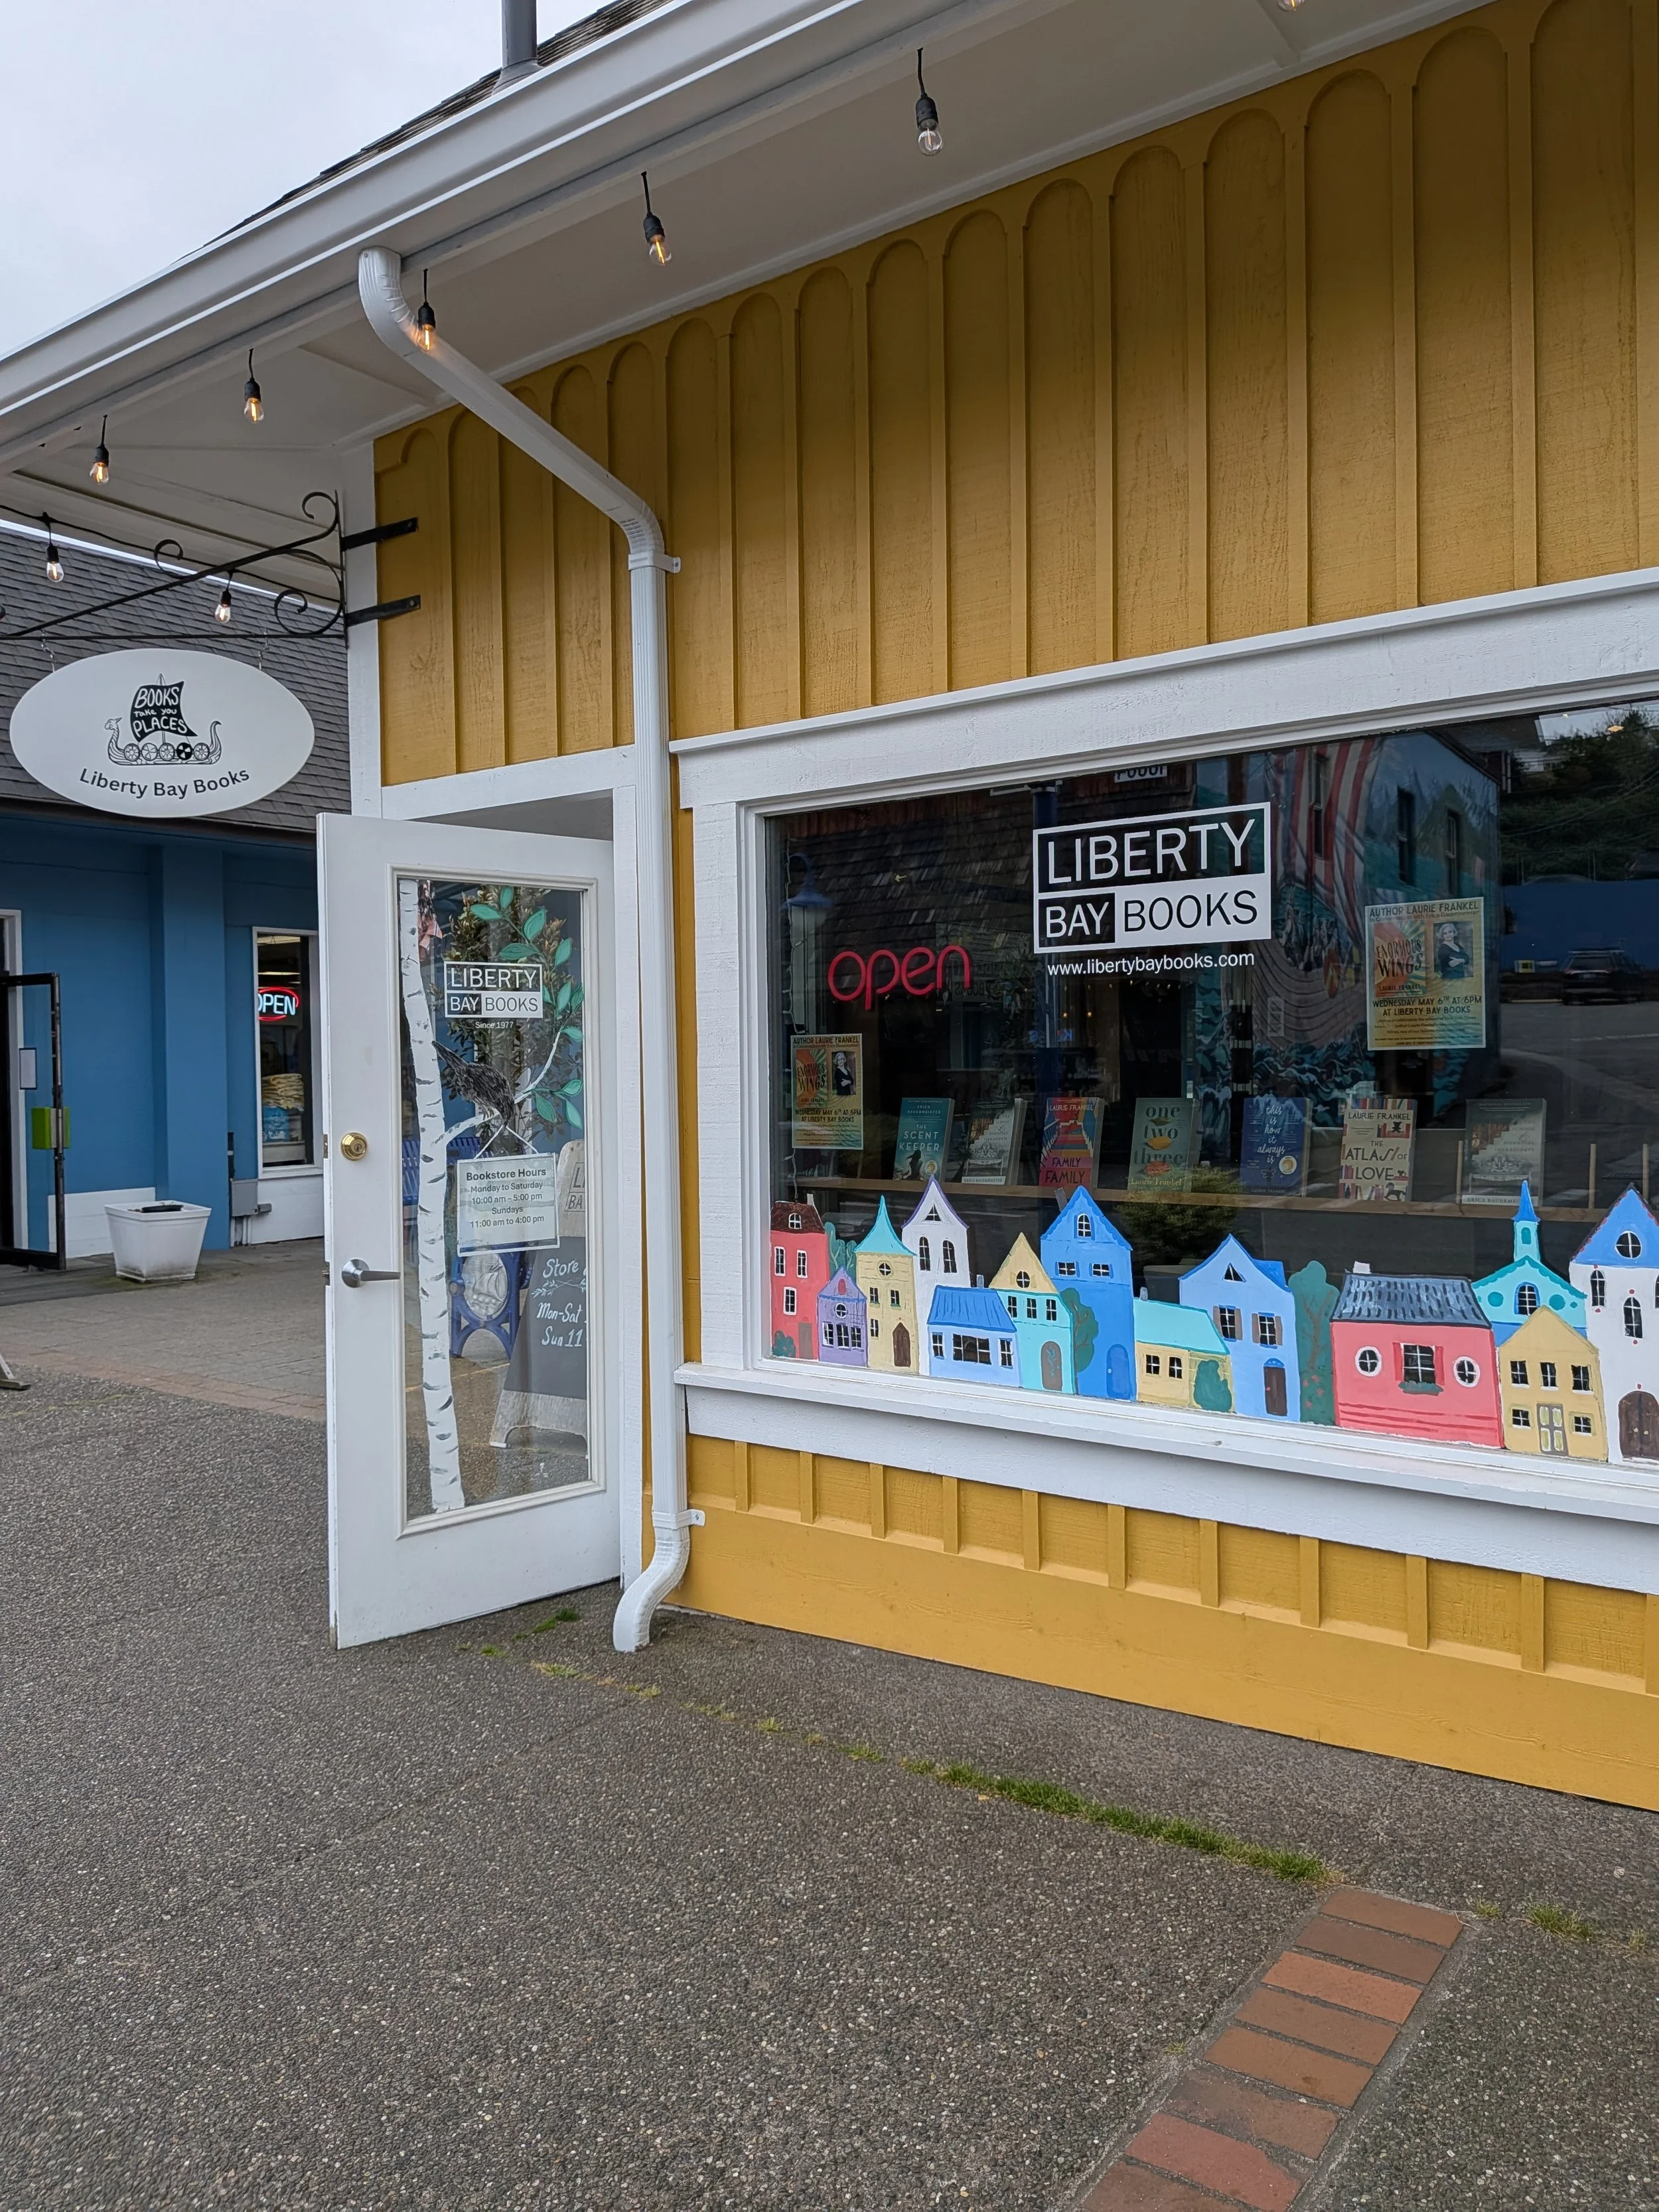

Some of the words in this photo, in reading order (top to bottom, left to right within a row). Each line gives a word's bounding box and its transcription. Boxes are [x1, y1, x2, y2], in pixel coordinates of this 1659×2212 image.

[134, 686, 180, 709] BOOKS
[133, 716, 188, 737] PLACES
[79, 767, 148, 798] Liberty
[153, 782, 188, 800] Bay
[193, 769, 250, 794] Books
[1048, 818, 1256, 885] LIBERTY
[1045, 901, 1110, 938] BAY
[1123, 889, 1258, 932] BOOKS
[1369, 907, 1404, 917] AUTHOR
[1406, 904, 1435, 914] LAURIE
[1439, 901, 1479, 912] FRANKEL
[1376, 939, 1422, 958] ENORMOUS
[1047, 952, 1255, 976] www.libertybaybooks.com
[1377, 952, 1423, 977] WINGS
[451, 967, 537, 989] LIBERTY
[828, 944, 972, 1011] open
[451, 996, 480, 1011] BAY
[485, 997, 538, 1011] BOOKS
[1372, 998, 1417, 1008] WEDNESDAY
[1444, 1005, 1471, 1014] BOOKS
[798, 1074, 826, 1092] WINGS
[1145, 1106, 1181, 1118] one
[1265, 1104, 1282, 1115] this
[1269, 1116, 1277, 1126] is
[903, 1130, 939, 1140] SCENT
[1144, 1125, 1179, 1140] two
[1264, 1124, 1282, 1134] how
[899, 1142, 940, 1151] KEEPER
[1257, 1143, 1286, 1157] always
[1133, 1147, 1185, 1167] three
[1267, 1155, 1275, 1164] is
[1345, 1147, 1394, 1161] ATLAS
[1052, 1157, 1082, 1167] FAMILY
[466, 1171, 516, 1181] Bookstore
[518, 1168, 546, 1177] Hours
[1045, 1170, 1086, 1184] FAMILY
[1131, 1177, 1153, 1185] Laurie
[1355, 1167, 1394, 1181] LOVE
[470, 1185, 500, 1193] Monday
[510, 1181, 543, 1190] Saturday
[472, 1196, 493, 1205] 10:00
[530, 1193, 543, 1202] pm
[492, 1206, 524, 1215] Sundays
[470, 1219, 491, 1228] 11:00
[515, 1216, 532, 1224] 4:00
[532, 1215, 545, 1224] pm
[542, 1258, 579, 1279] Store
[536, 1302, 583, 1323] Mon-Sat
[541, 1325, 563, 1347] Sun
[564, 1328, 583, 1347] 11
